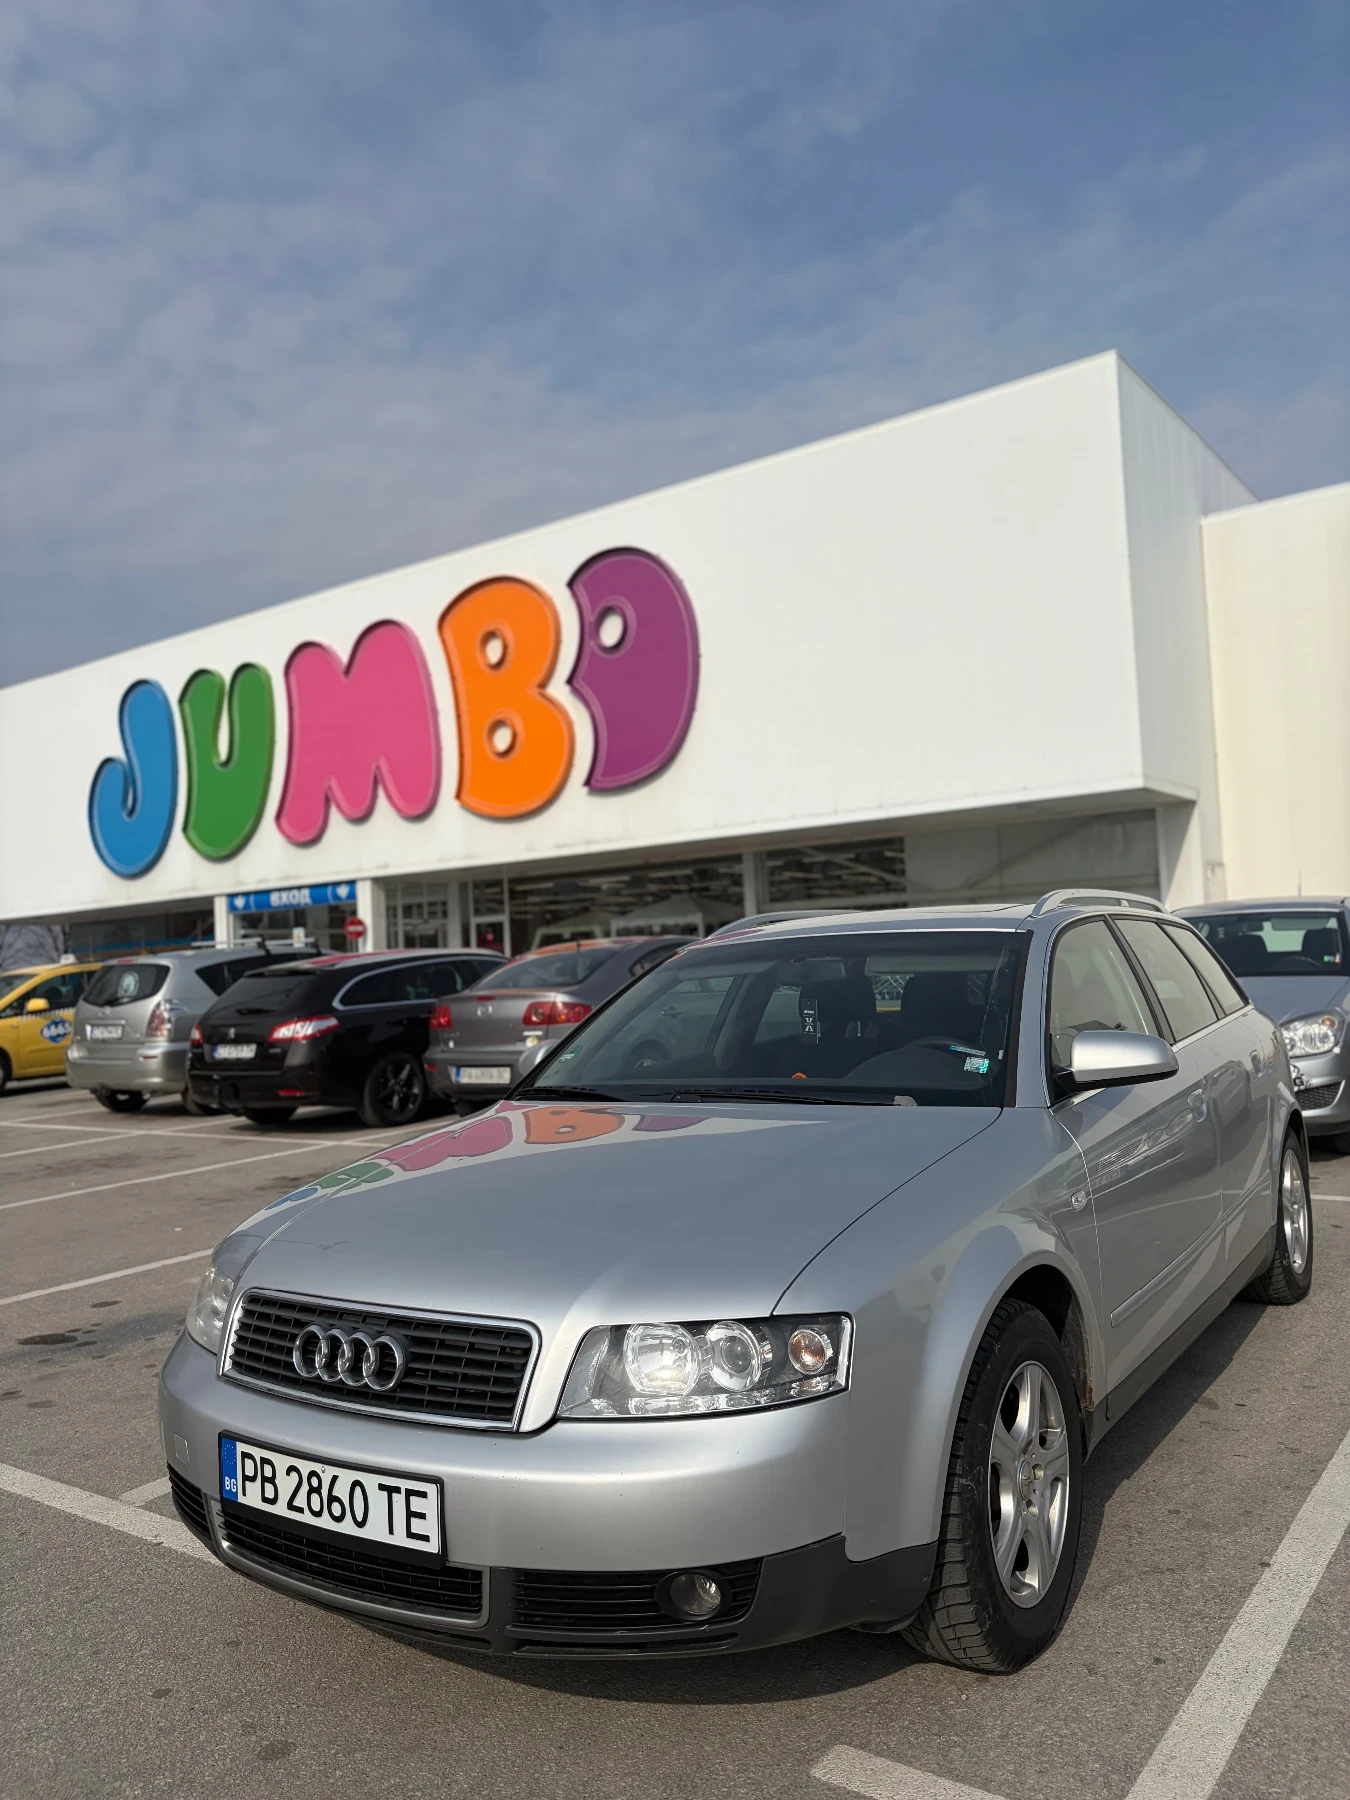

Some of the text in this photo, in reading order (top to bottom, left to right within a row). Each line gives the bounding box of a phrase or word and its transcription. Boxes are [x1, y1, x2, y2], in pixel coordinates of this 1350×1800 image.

[88, 545, 700, 879] JUMBO
[269, 887, 312, 907] ВХОД
[224, 1476, 237, 1493] BG
[240, 1450, 431, 1543] PB 2860 TE
